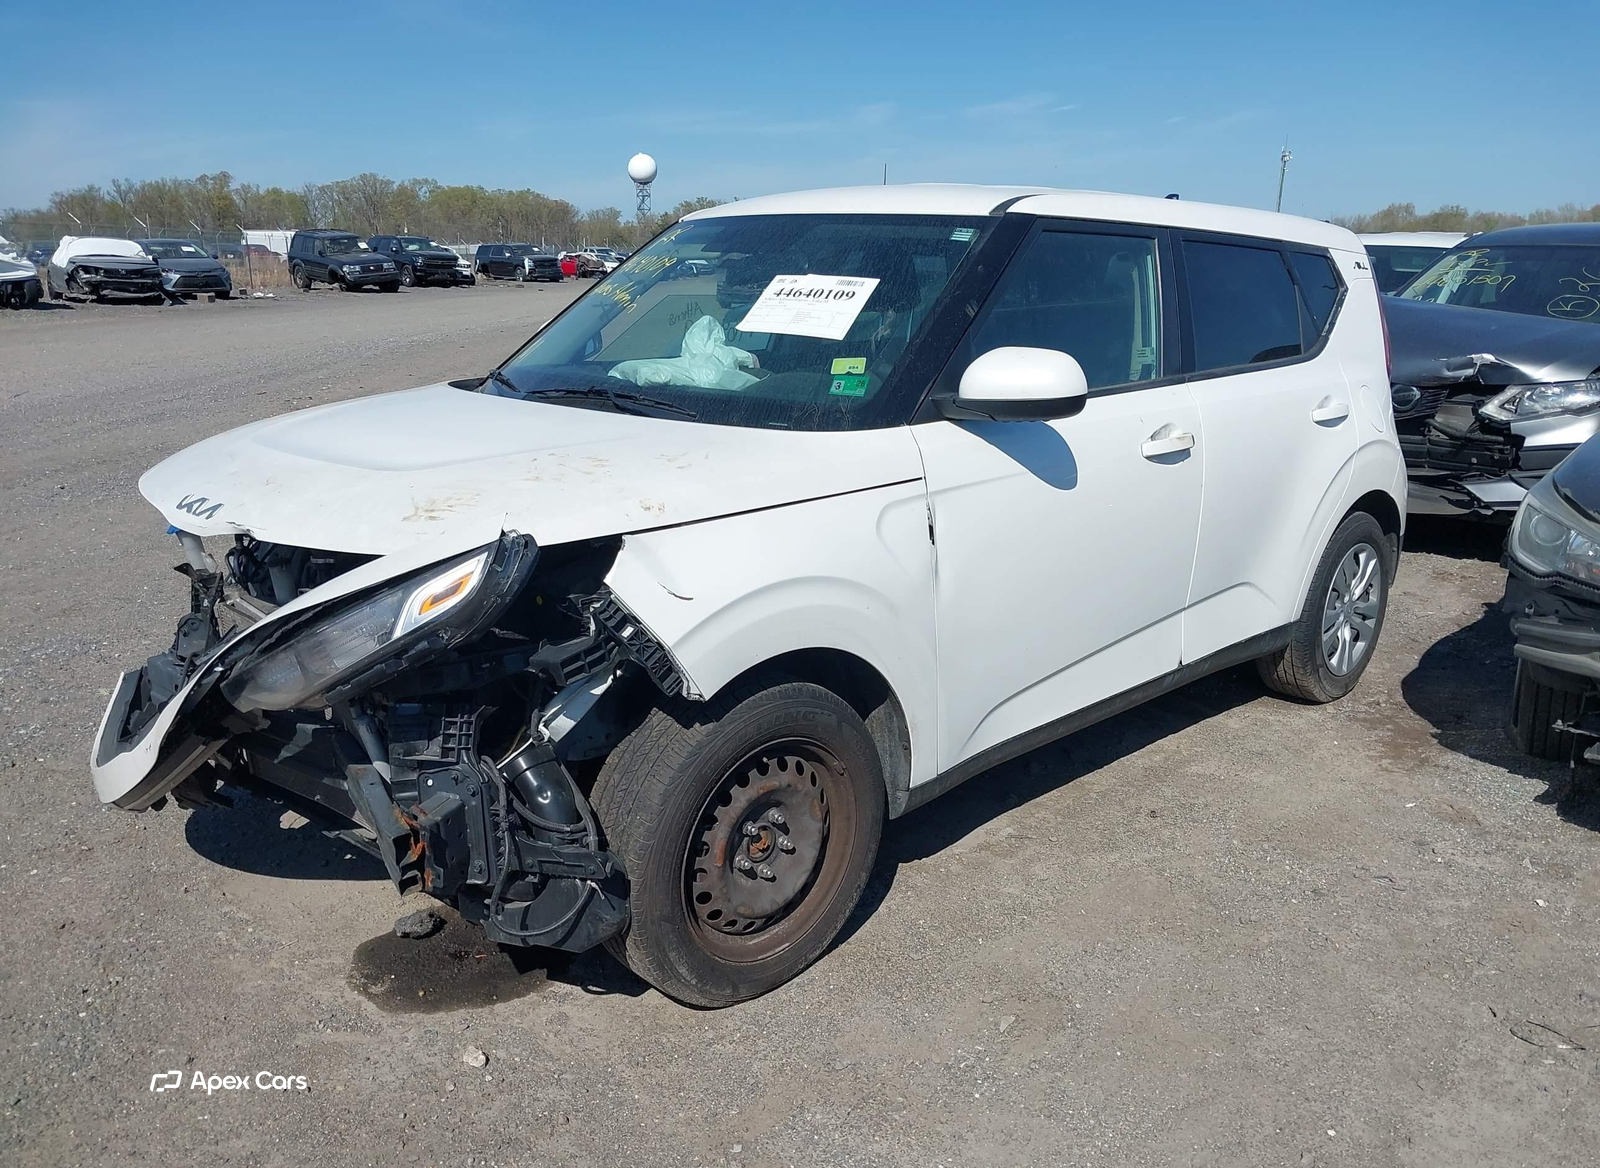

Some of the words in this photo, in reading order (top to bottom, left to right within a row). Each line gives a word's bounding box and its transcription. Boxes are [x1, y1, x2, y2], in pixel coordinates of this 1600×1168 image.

[773, 287, 856, 301] 44640109
[834, 381, 842, 390] 3
[176, 493, 225, 520] KIA
